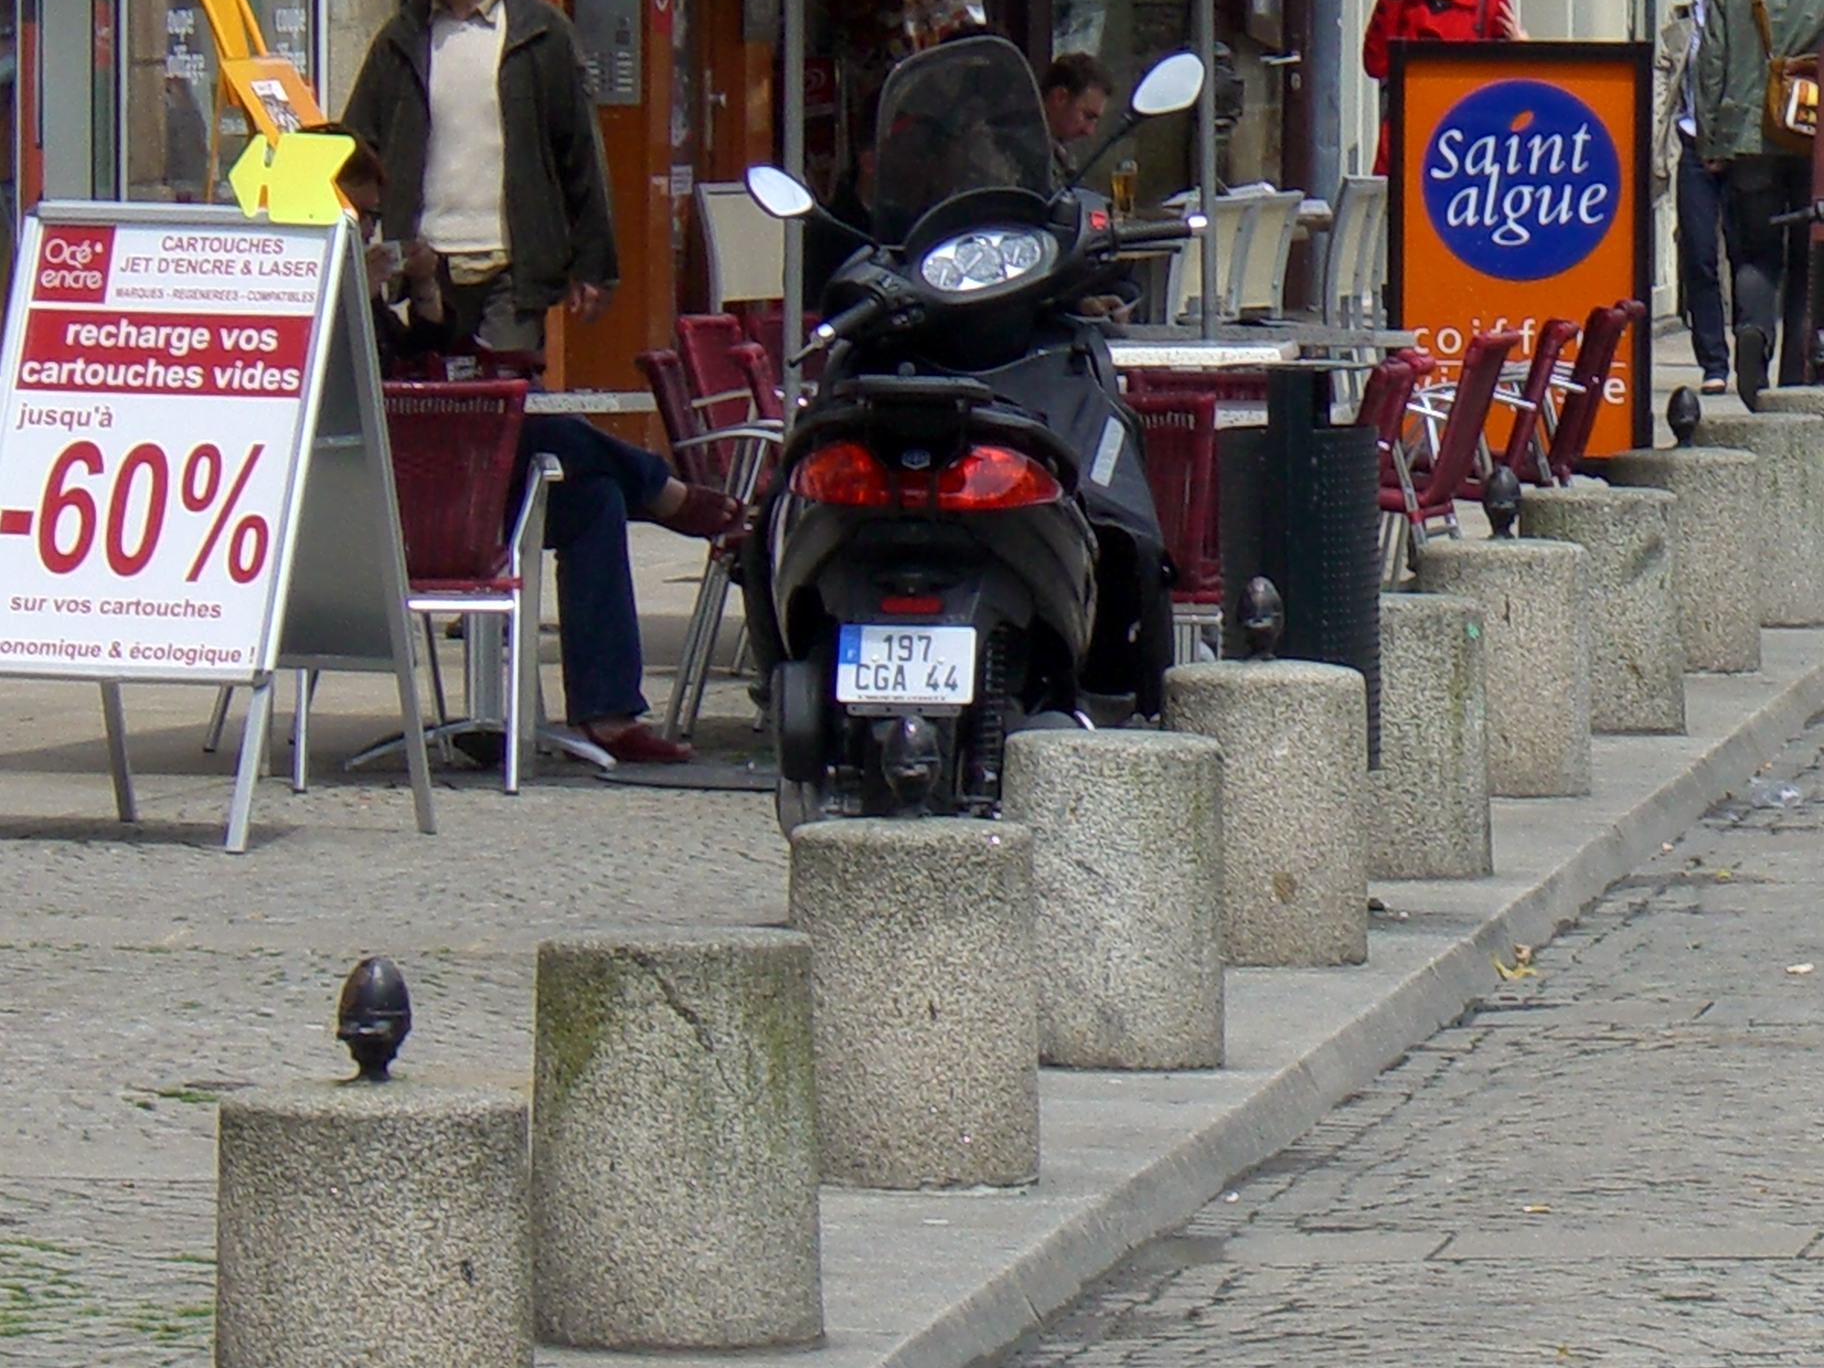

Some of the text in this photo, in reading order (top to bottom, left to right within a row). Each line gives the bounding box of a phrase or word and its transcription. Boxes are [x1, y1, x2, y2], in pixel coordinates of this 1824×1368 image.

[1447, 162, 1608, 246] algue
[162, 235, 284, 255] CARTOUCHES
[119, 256, 318, 278] JET D'ENCRE & LASER
[65, 319, 279, 357] recharge vos
[21, 359, 300, 392] cartouches vides
[16, 403, 114, 432] jusqu'à
[0, 440, 269, 584] -60%
[10, 595, 222, 619] sur vos cartouches
[107, 642, 122, 660] &
[129, 643, 242, 666] écologique
[883, 634, 932, 662] 197
[854, 663, 958, 692] CGA 44
